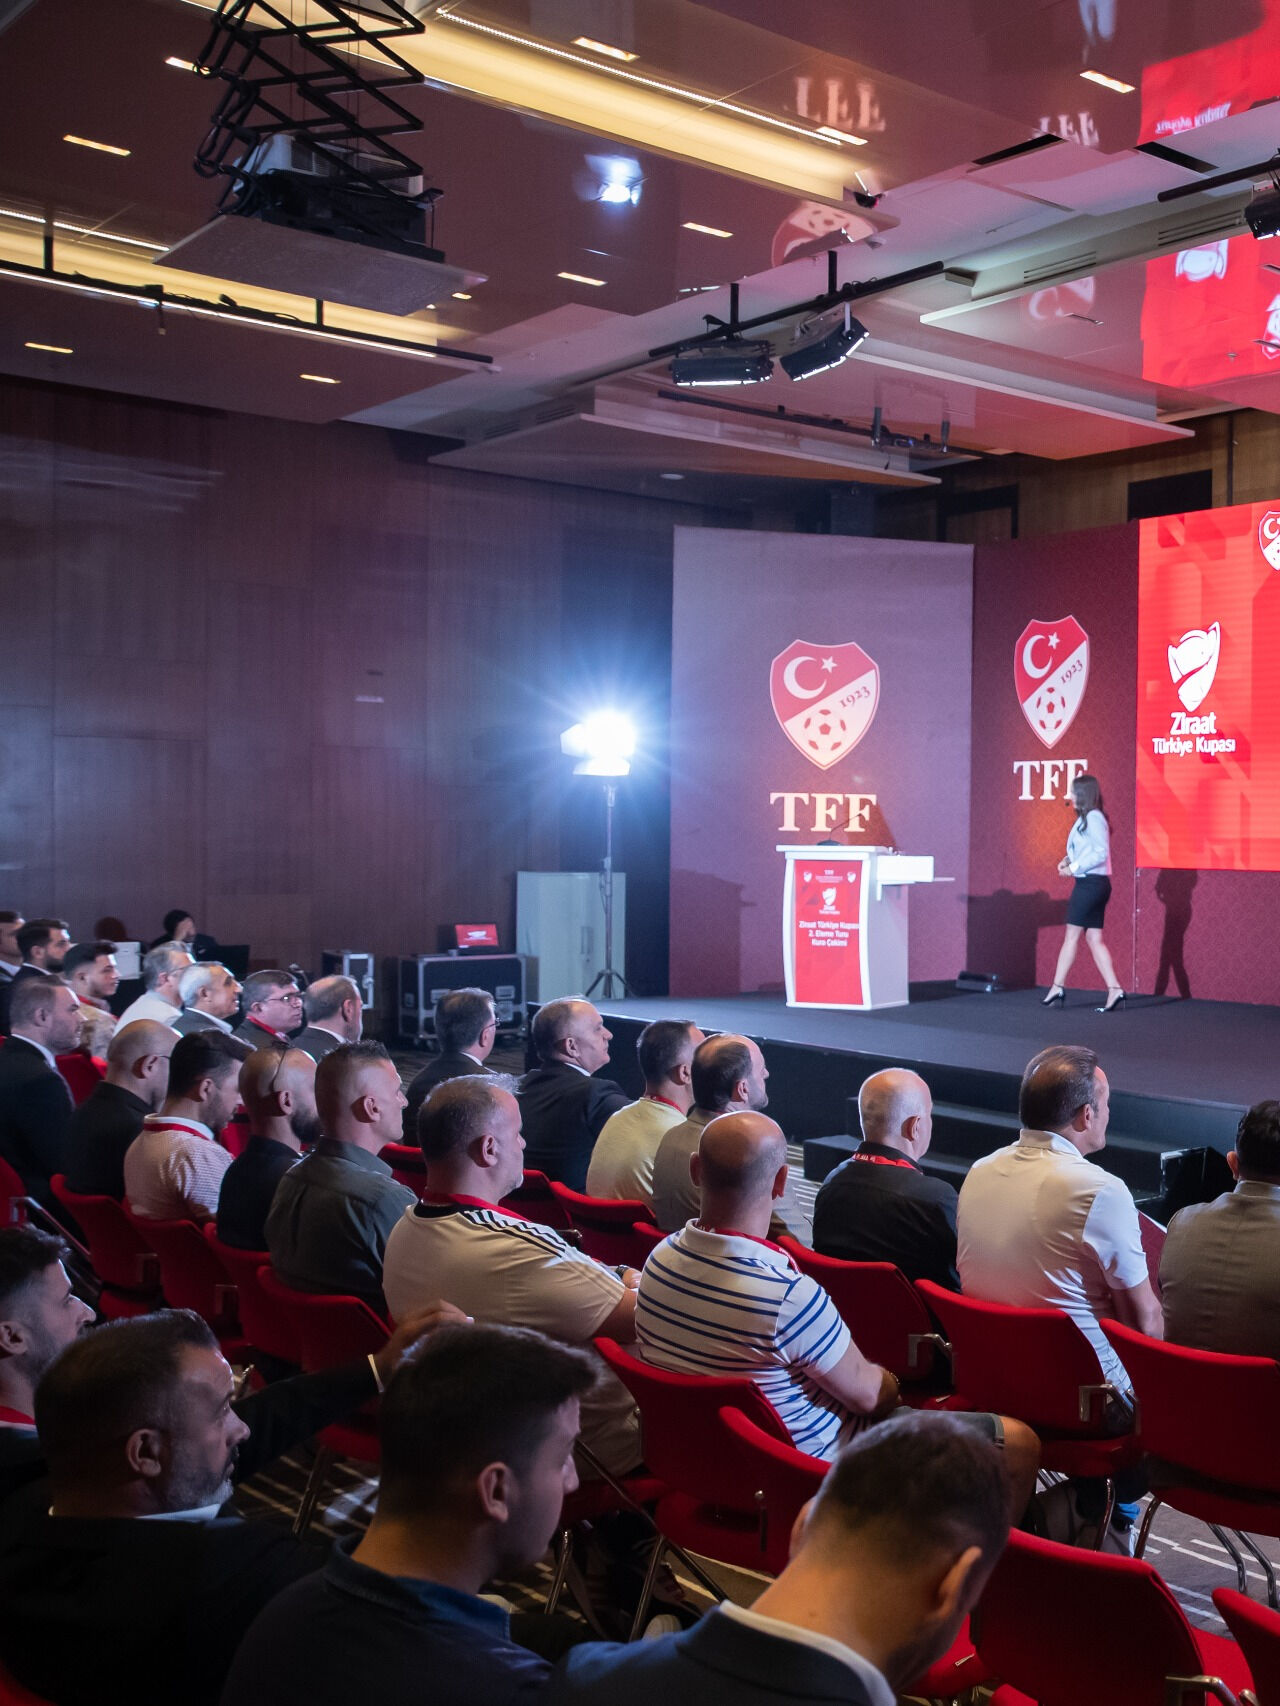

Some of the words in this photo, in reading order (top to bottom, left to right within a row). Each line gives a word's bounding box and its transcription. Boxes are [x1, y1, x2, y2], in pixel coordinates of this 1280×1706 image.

[1060, 659, 1083, 684] 1923
[839, 685, 871, 709] 1923
[1170, 711, 1217, 735] Ziraat
[1152, 736, 1193, 757] Türkiye
[1195, 736, 1236, 756] Kupası
[769, 792, 877, 832] TFF
